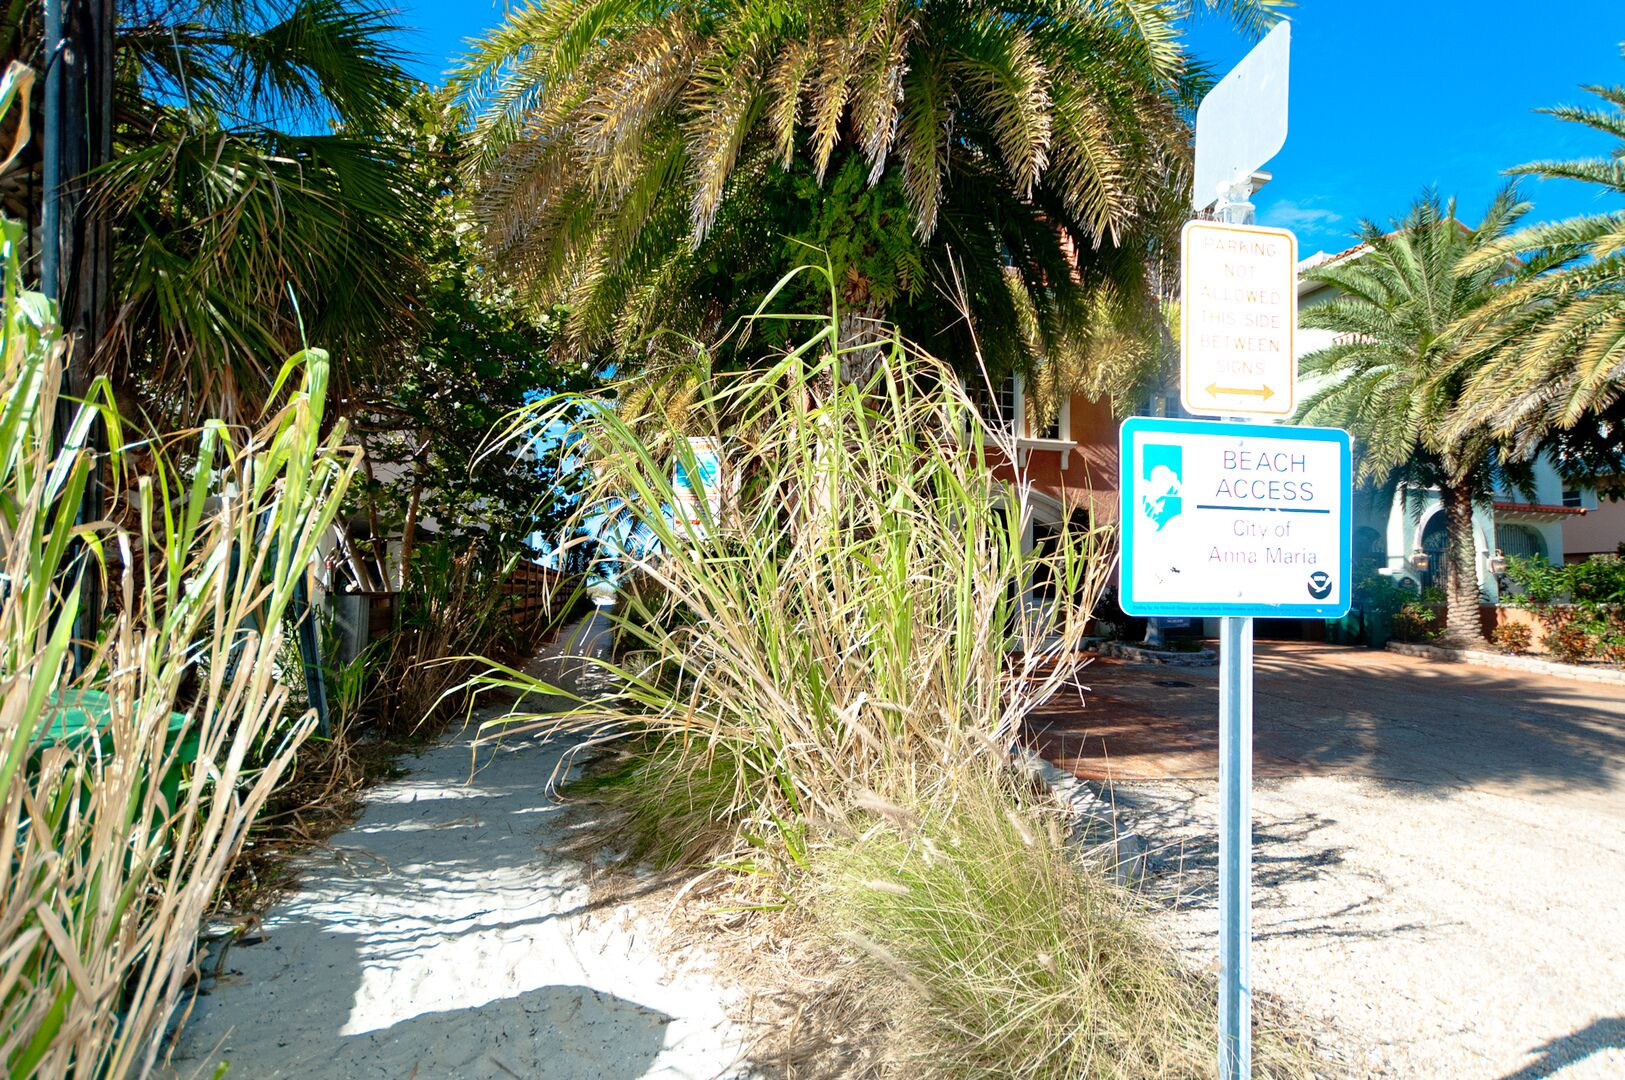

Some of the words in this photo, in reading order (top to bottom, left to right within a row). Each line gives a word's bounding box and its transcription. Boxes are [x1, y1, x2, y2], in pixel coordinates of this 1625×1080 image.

[1204, 237, 1277, 256] PARKING
[1224, 264, 1255, 280] NOT
[1201, 286, 1280, 304] ALLOWED
[1202, 310, 1236, 326] THIS
[1245, 314, 1280, 329] SIDE
[1200, 335, 1280, 352] BETWEEN
[1216, 360, 1265, 376] SIGNS
[1223, 450, 1305, 473] BEACH
[1215, 478, 1314, 502] ACCESS
[1233, 519, 1267, 541] City
[1274, 520, 1292, 537] of
[1208, 546, 1257, 564] Anna
[1266, 547, 1317, 565] Maria
